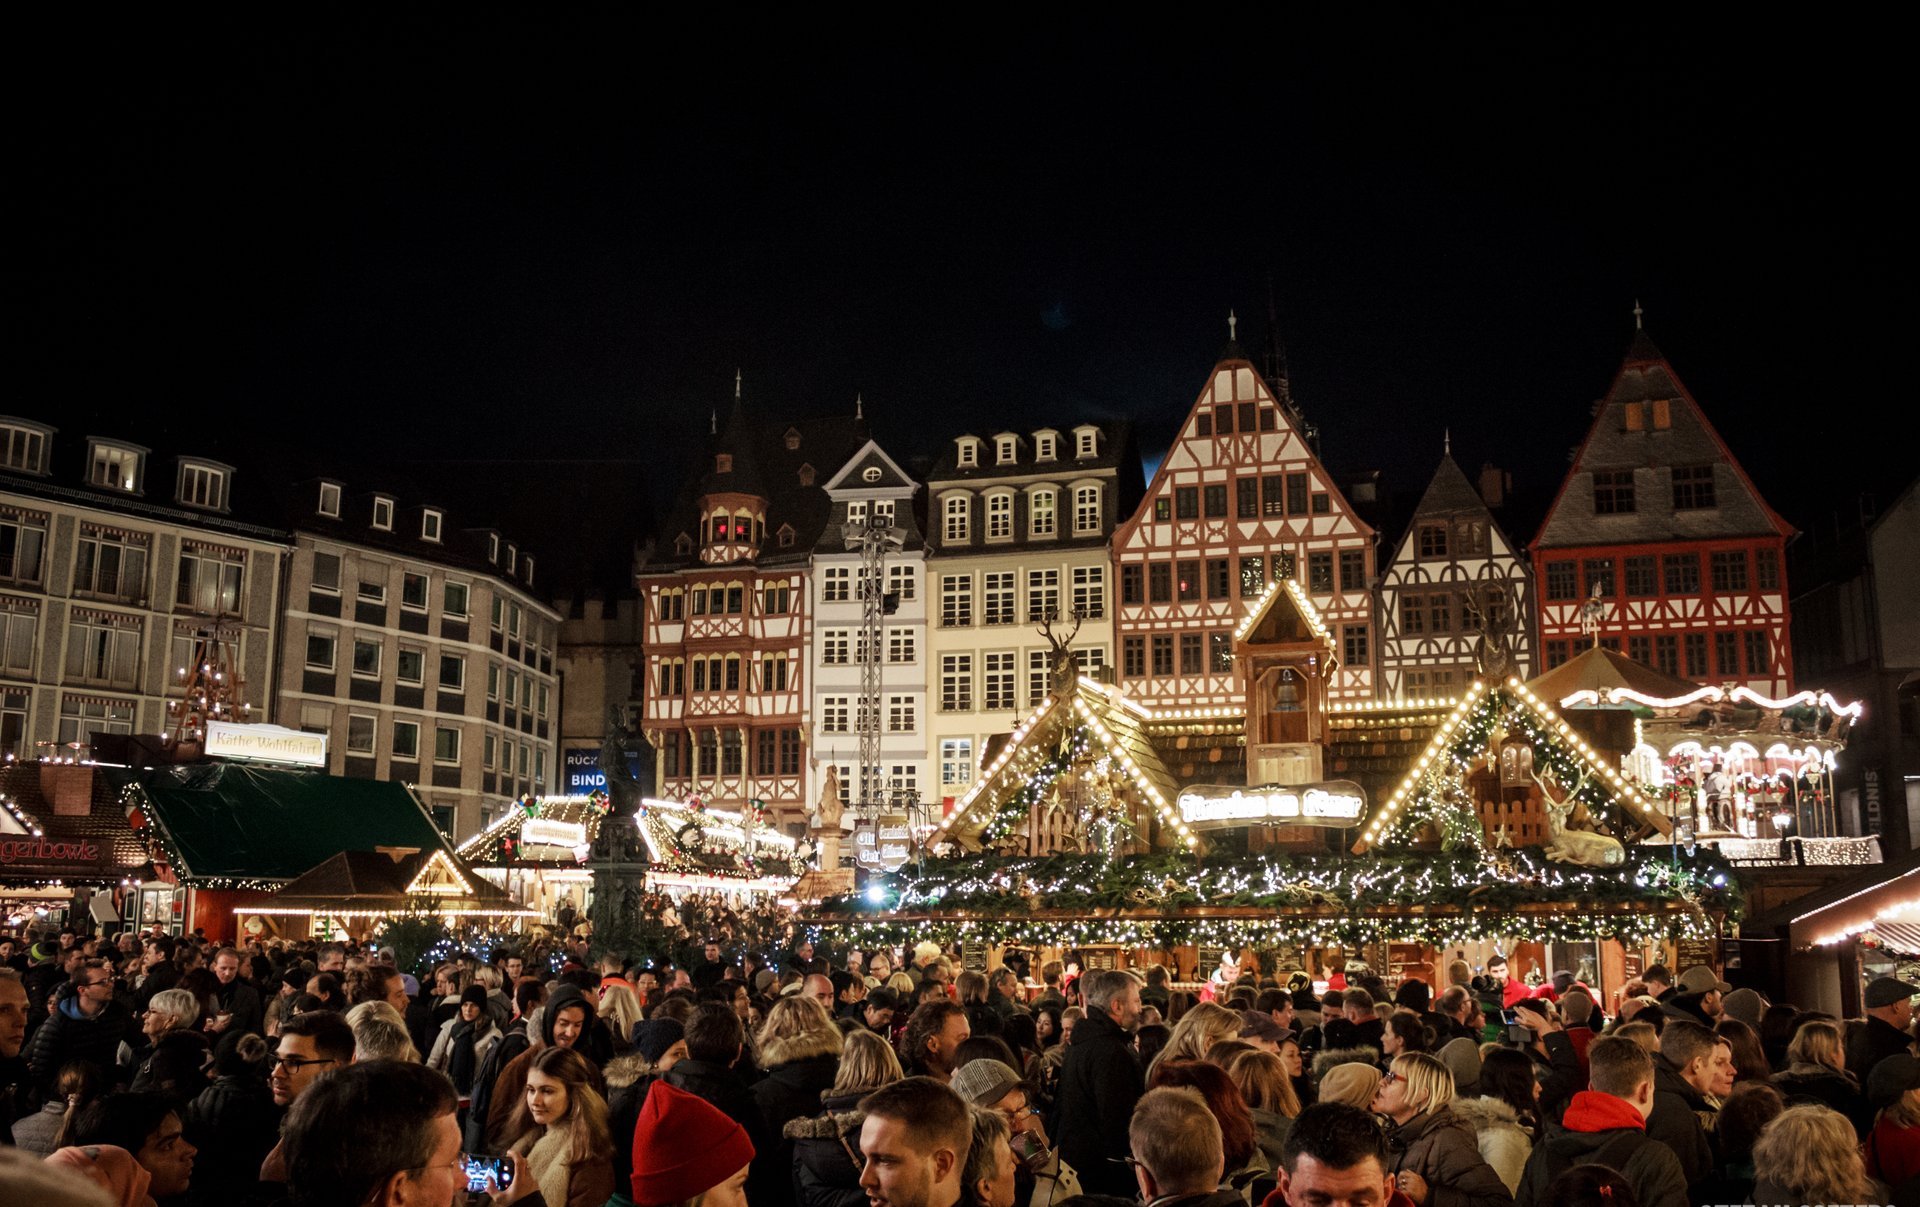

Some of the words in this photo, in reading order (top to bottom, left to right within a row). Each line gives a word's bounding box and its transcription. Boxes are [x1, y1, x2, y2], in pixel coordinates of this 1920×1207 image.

[215, 731, 252, 747] Käthe
[256, 736, 317, 755] Wohlfahrt
[0, 836, 99, 863] genbowle
